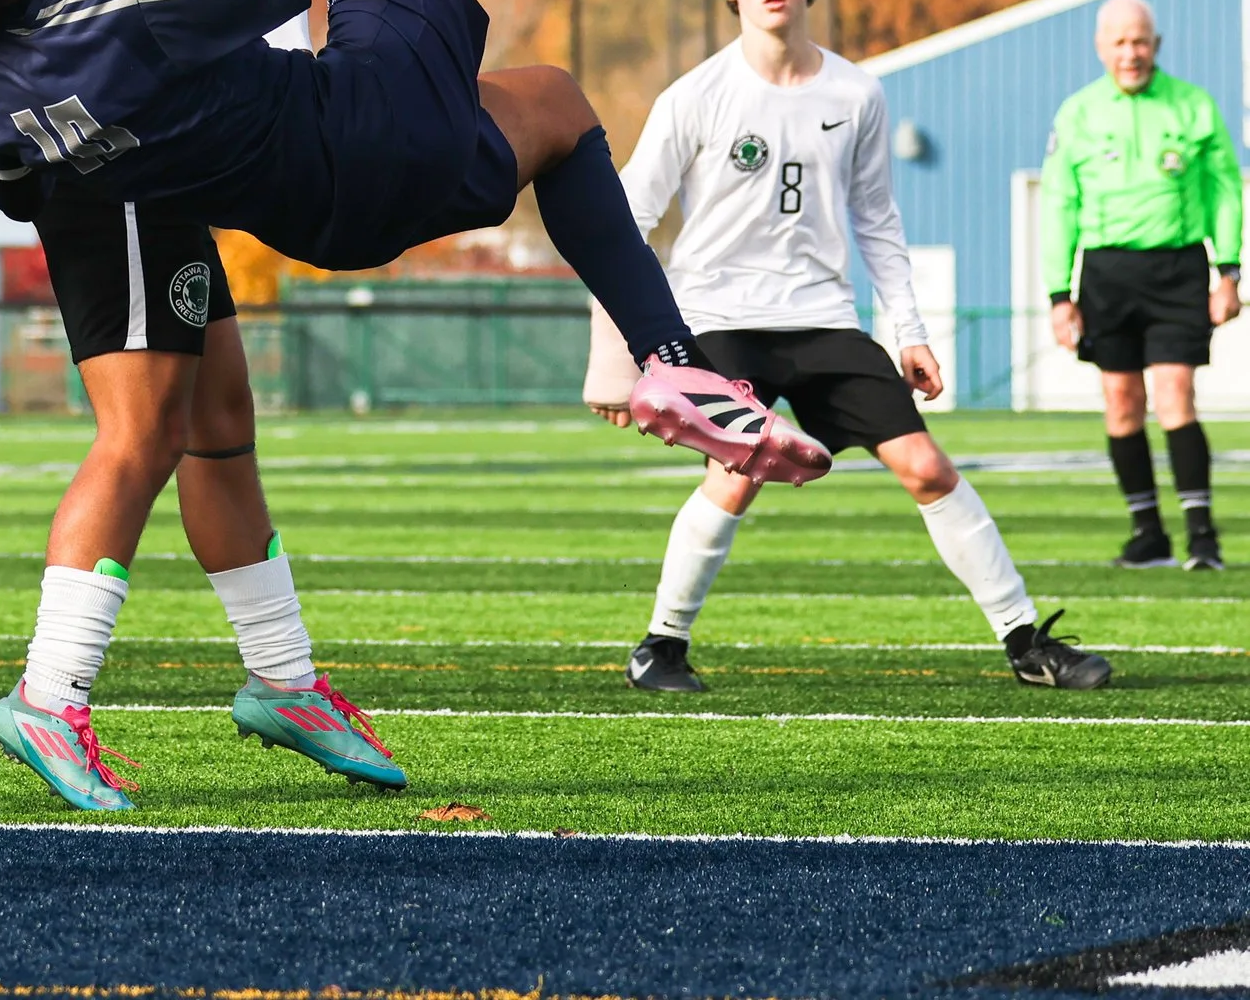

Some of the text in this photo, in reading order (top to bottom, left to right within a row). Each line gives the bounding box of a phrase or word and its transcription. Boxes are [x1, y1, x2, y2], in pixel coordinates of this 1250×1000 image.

[10, 95, 140, 174] 10
[780, 162, 802, 213] 8
[174, 266, 202, 292] OTTAWA
[175, 298, 200, 322] GREEN
